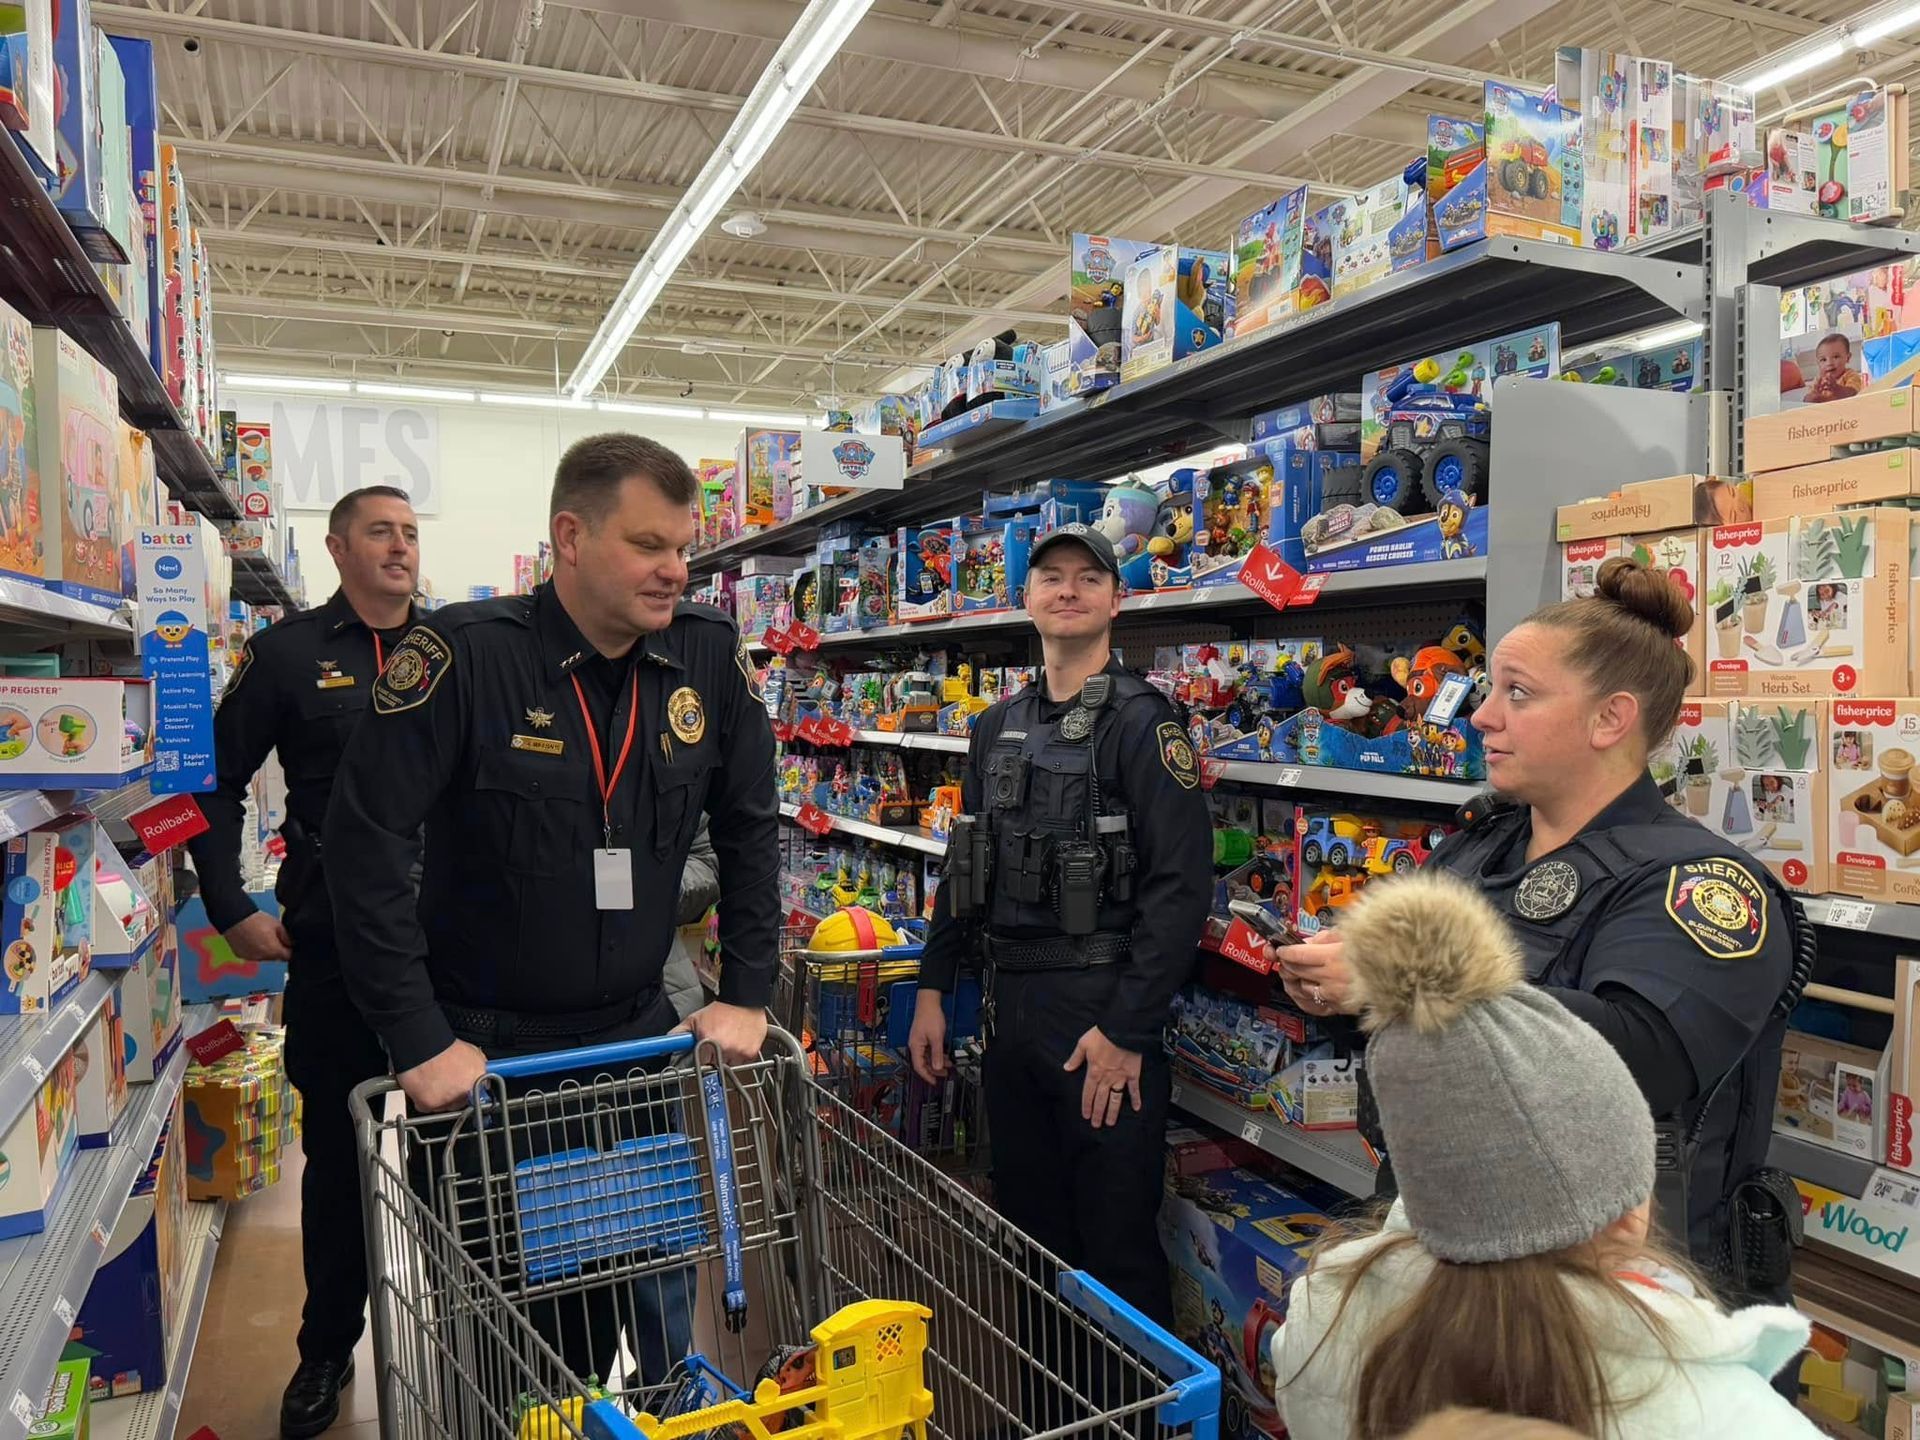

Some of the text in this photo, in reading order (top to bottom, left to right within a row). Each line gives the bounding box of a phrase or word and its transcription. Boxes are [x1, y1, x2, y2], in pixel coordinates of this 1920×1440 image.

[1788, 418, 1859, 441] fisher-price
[1792, 478, 1858, 499] fisher-price
[142, 532, 193, 545] battat
[1715, 528, 1760, 541] fisher-price
[1568, 544, 1605, 556] fisher-price
[1720, 553, 1730, 565] 12
[158, 564, 179, 572] New!
[166, 587, 188, 595] Many
[1242, 570, 1283, 606] Rollback
[146, 595, 167, 603] Ways
[179, 594, 196, 604] Play
[1885, 563, 1900, 644] fisher-price
[185, 655, 200, 663] Play
[178, 671, 206, 679] Learning
[182, 687, 196, 695] Play
[1762, 682, 1811, 694] Herb Set
[1837, 705, 1893, 719] fisher-price
[1904, 717, 1916, 730] 15
[183, 753, 210, 761] Explore
[143, 808, 197, 840] Rollback
[1846, 855, 1876, 866] Develops
[1683, 863, 1760, 900] SHERIFF
[1688, 920, 1743, 949] BLOUNT COUNTY
[1225, 942, 1268, 971] Rollback
[196, 1030, 235, 1056] Rollback
[719, 1172, 732, 1216] Walmart
[1823, 1200, 1909, 1253] Wood
